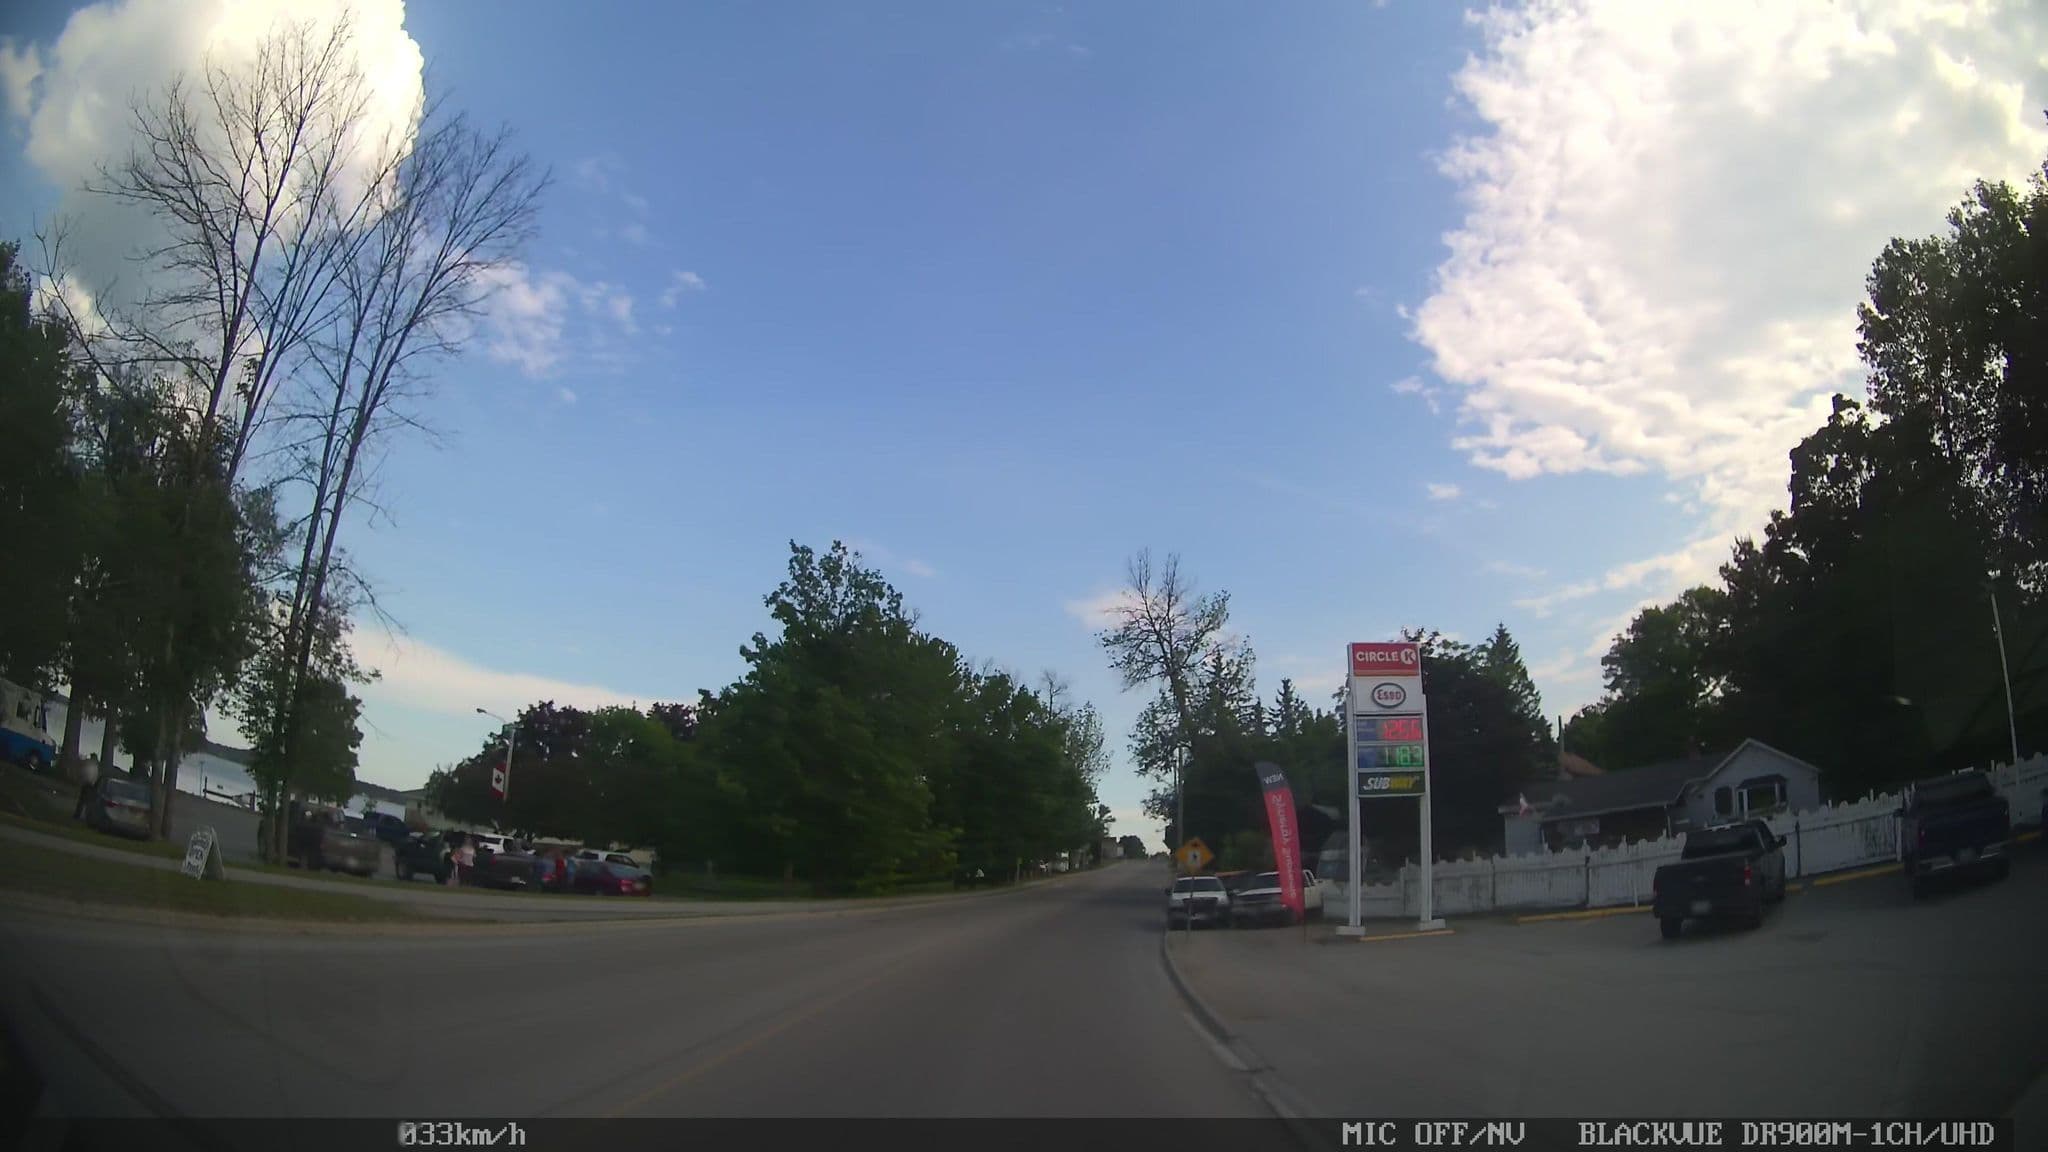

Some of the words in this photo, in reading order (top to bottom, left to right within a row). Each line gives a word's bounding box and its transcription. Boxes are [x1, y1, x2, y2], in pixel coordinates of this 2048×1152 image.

[1356, 651, 1399, 662] CIRCLE
[1402, 649, 1416, 663] K
[1376, 689, 1402, 700] Esso
